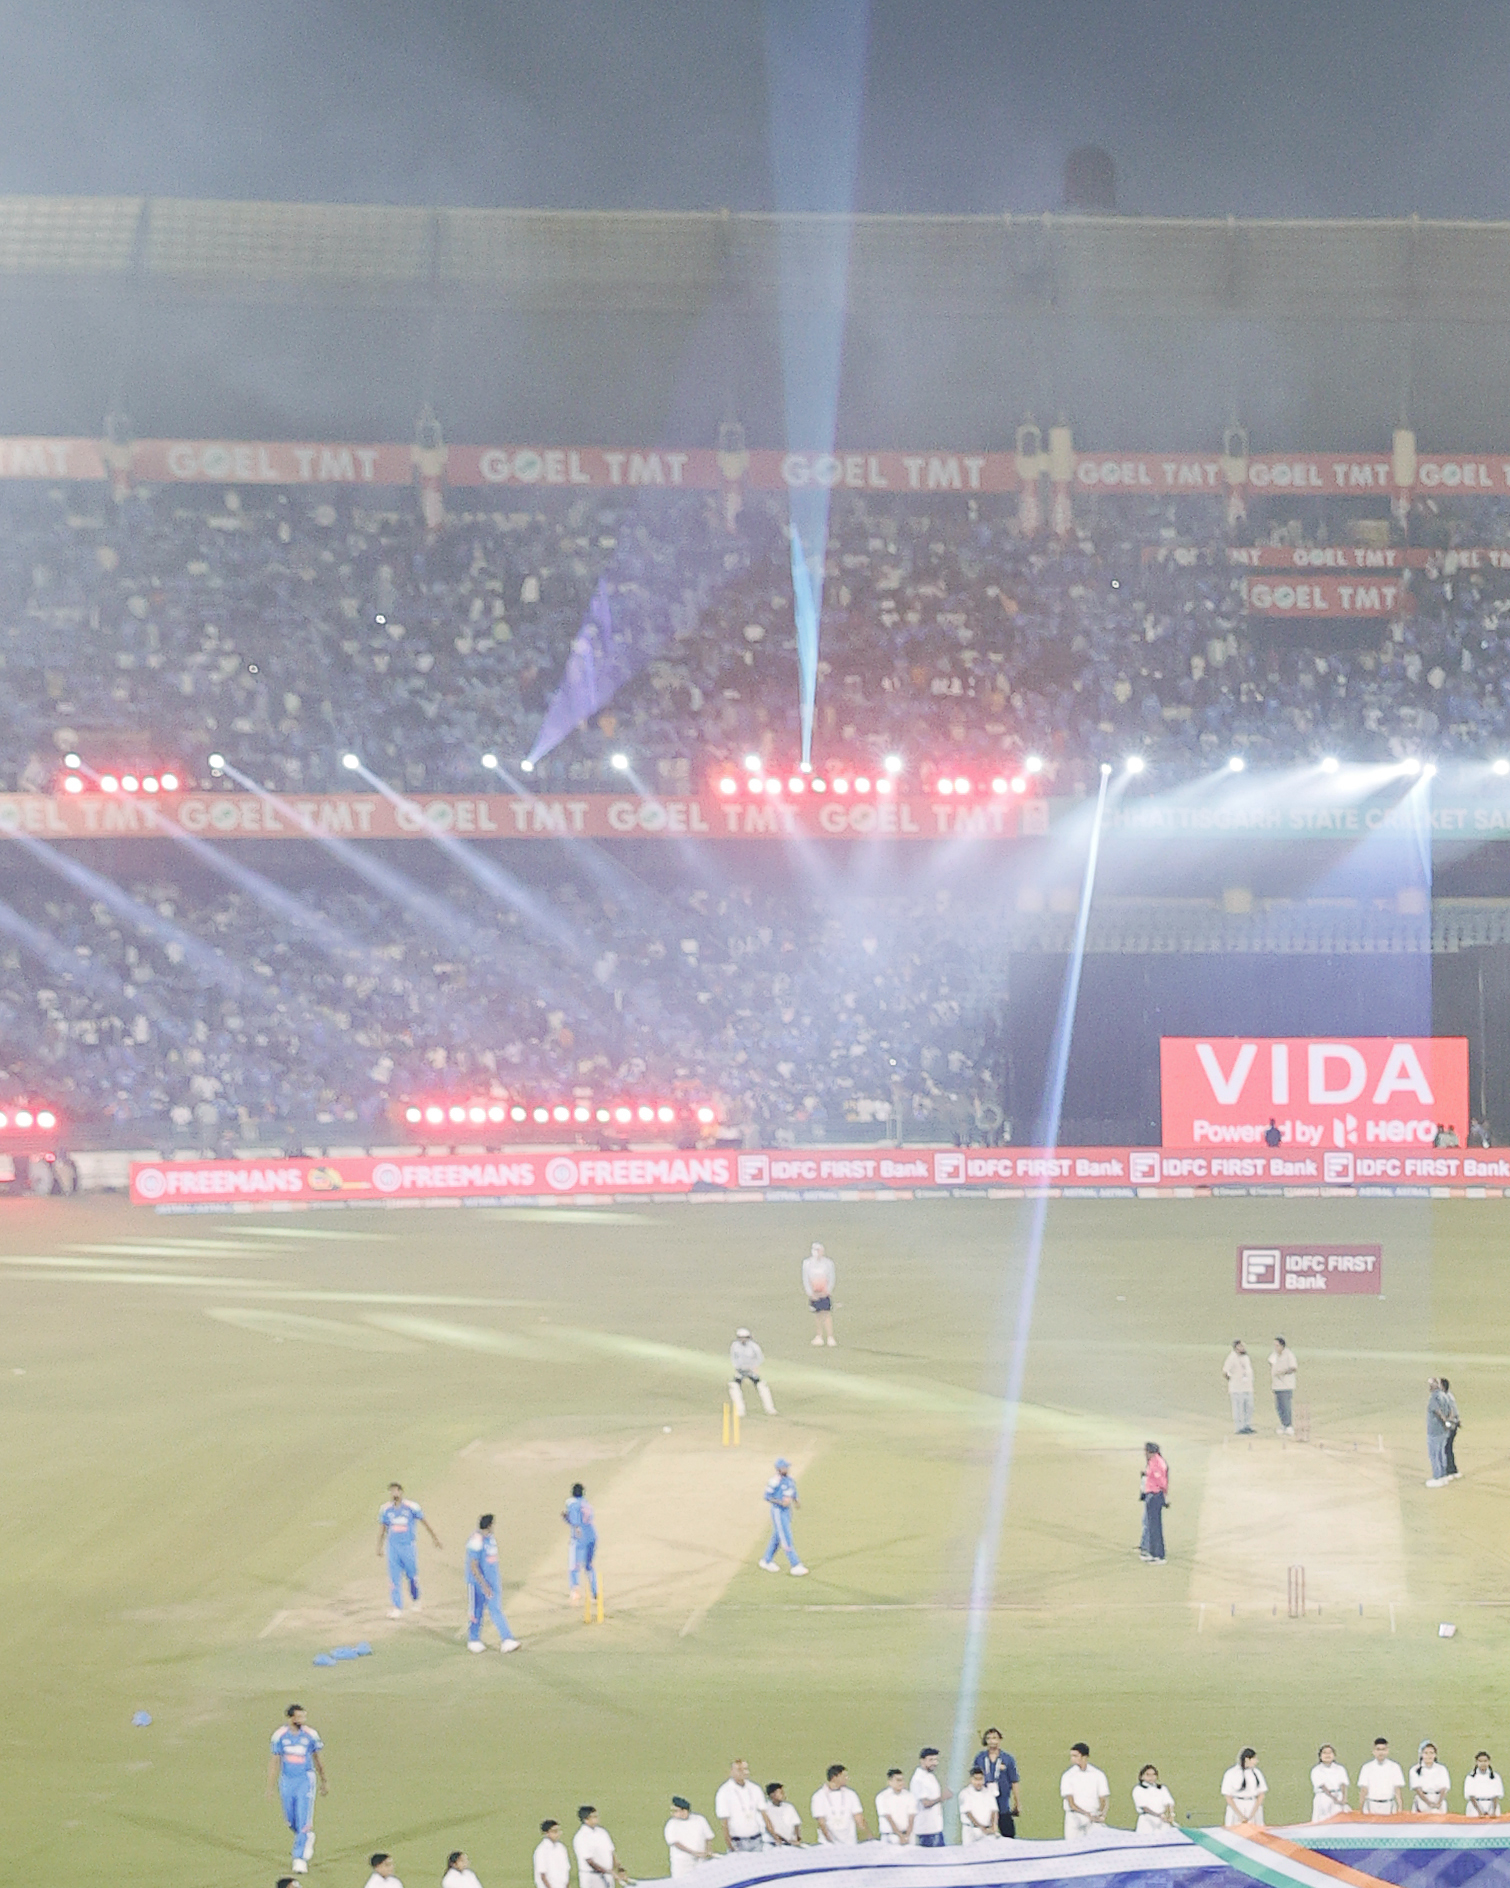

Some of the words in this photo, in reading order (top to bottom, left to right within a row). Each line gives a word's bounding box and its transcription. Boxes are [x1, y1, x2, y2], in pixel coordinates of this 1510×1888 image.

[166, 443, 279, 479] GOEL
[294, 447, 379, 481] TMT
[480, 449, 591, 484] GOEL
[604, 452, 689, 485] TMT
[783, 454, 889, 488] GOEL
[903, 455, 986, 489] TMT
[1078, 462, 1148, 485] GOEL
[1161, 462, 1220, 487] TMT
[1247, 463, 1323, 487] GOEL
[1332, 464, 1391, 487] TMT
[1419, 463, 1494, 487] GOEL
[1353, 547, 1397, 567] TMT
[1249, 584, 1330, 611] GOEL
[1337, 585, 1397, 612] TMT
[179, 803, 284, 832] GOEL
[297, 802, 378, 832] TMT
[397, 801, 500, 832] GOEL
[509, 801, 591, 832] TMT
[608, 801, 708, 833] GOEL
[723, 803, 800, 834] TMT
[819, 804, 920, 835] GOEL
[931, 804, 1012, 835] TMT
[1194, 1042, 1436, 1105] VIDA
[1193, 1119, 1291, 1144] Powerd
[1295, 1119, 1324, 1147] by
[166, 1164, 303, 1193] FREEMANS
[402, 1162, 536, 1190] FREEMANS
[578, 1157, 730, 1187] FREEMANS
[771, 1160, 817, 1179] IDFC
[820, 1160, 877, 1179] FIRST
[881, 1160, 929, 1179] Bank
[966, 1159, 1012, 1178] IDFC
[1016, 1159, 1071, 1178] FIRST
[1077, 1159, 1124, 1178] Bank
[1161, 1159, 1207, 1177] IDFC
[1210, 1159, 1266, 1177] FIRST
[1269, 1159, 1318, 1177] Bank
[1356, 1159, 1402, 1177] IDFC
[1404, 1159, 1460, 1177] FIRST
[1463, 1159, 1510, 1177] Bank
[1285, 1254, 1326, 1272] IDFC
[1327, 1254, 1377, 1273] FIRST
[1284, 1272, 1328, 1290] Bank
